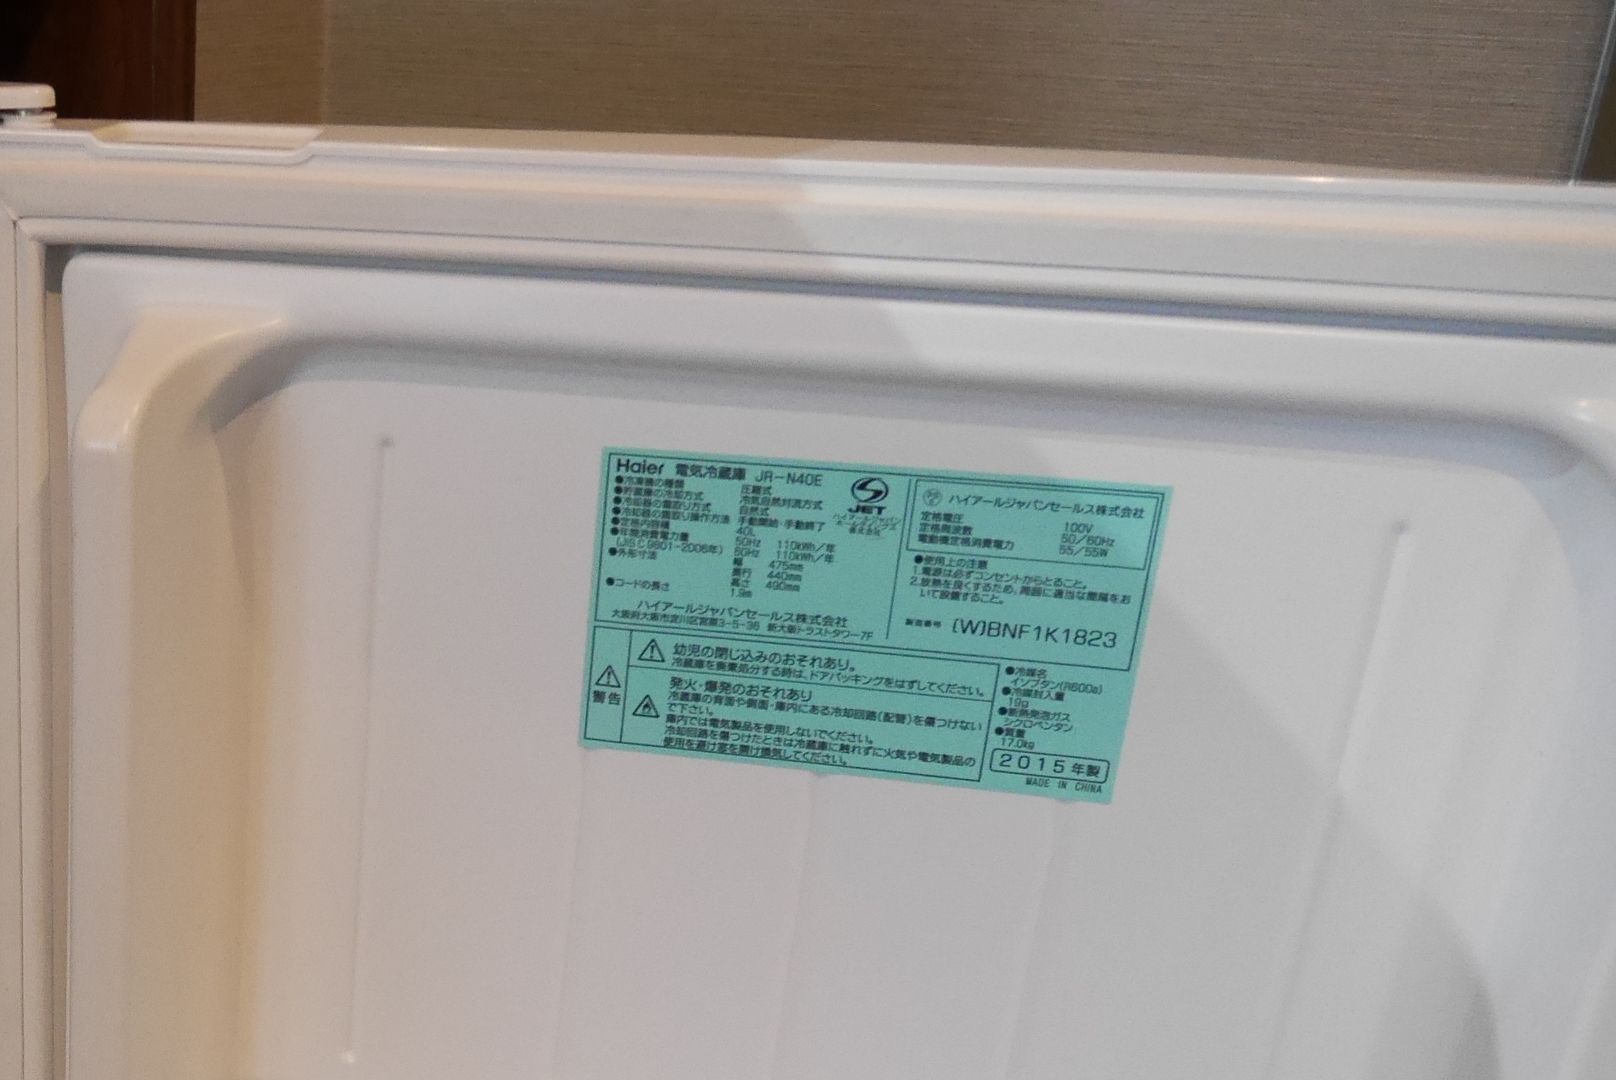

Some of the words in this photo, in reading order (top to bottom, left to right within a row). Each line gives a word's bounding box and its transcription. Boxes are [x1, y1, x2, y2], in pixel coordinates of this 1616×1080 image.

[616, 457, 664, 473] Haier
[675, 462, 746, 480] 電気冷蔵庫
[740, 505, 770, 516] 自然式
[848, 503, 887, 515] JET
[949, 492, 1146, 518] ハイアールジャパンセールス株式会社
[919, 521, 974, 535] 定格周波数
[921, 510, 964, 523] 定格電圧
[1064, 521, 1094, 533] 100V
[618, 547, 658, 559] 外形寸法
[923, 554, 989, 569] 使用上の注意
[615, 577, 670, 591] コードの長さ
[731, 578, 751, 588] 高さ
[638, 597, 848, 628] ハイアールジャパンセールス株式会社
[673, 642, 856, 671] 幼児の閉じ込みのおそれあり。
[1014, 666, 1048, 678] 冷媒名
[669, 675, 812, 701] 発火・爆発のおそれあり
[592, 690, 622, 705] 警告
[667, 701, 714, 716] で下さい。
[666, 713, 874, 744] 庫内では電気製品を使用しないでください。
[999, 753, 1102, 777] 2015年製
[1025, 776, 1050, 788] MADE
[1058, 780, 1068, 790] IN
[1074, 782, 1103, 794] CHINA
